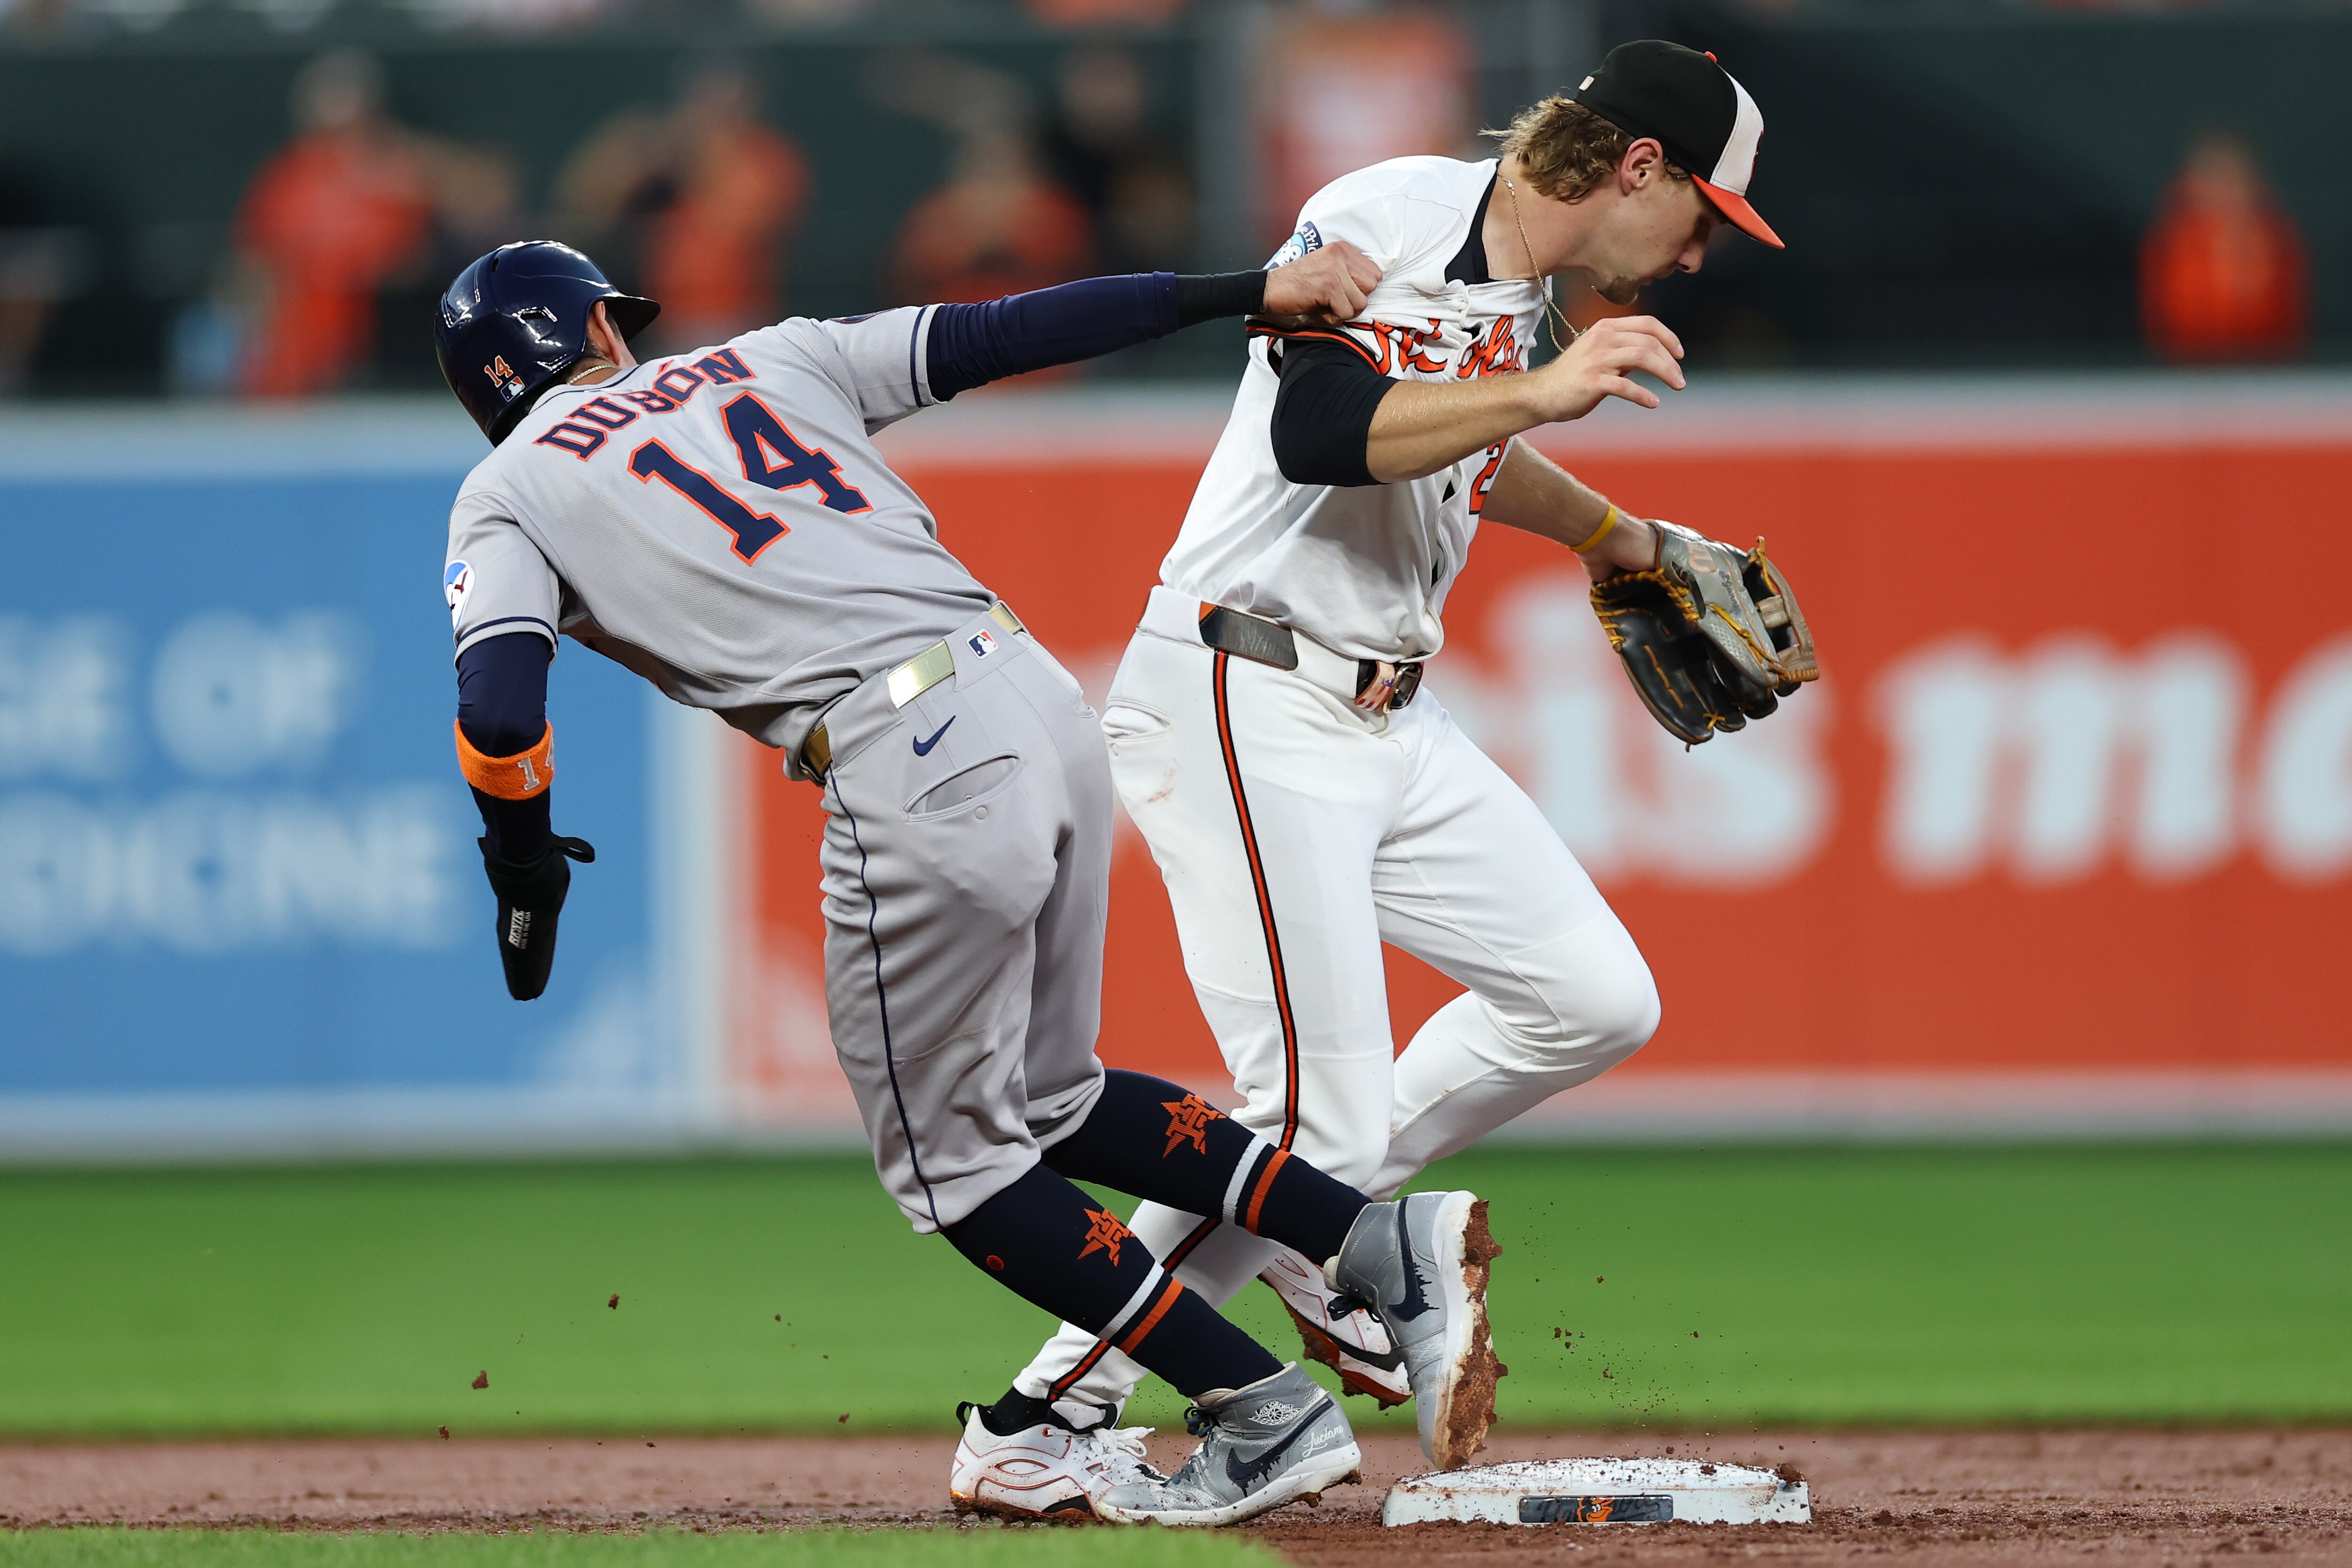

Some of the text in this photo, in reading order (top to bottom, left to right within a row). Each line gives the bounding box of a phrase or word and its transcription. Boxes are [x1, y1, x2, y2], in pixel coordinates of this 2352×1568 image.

[484, 355, 514, 388] 14
[532, 348, 755, 462] DUBÓN
[628, 390, 874, 566] 14
[1302, 1425, 1344, 1457] Luciano
